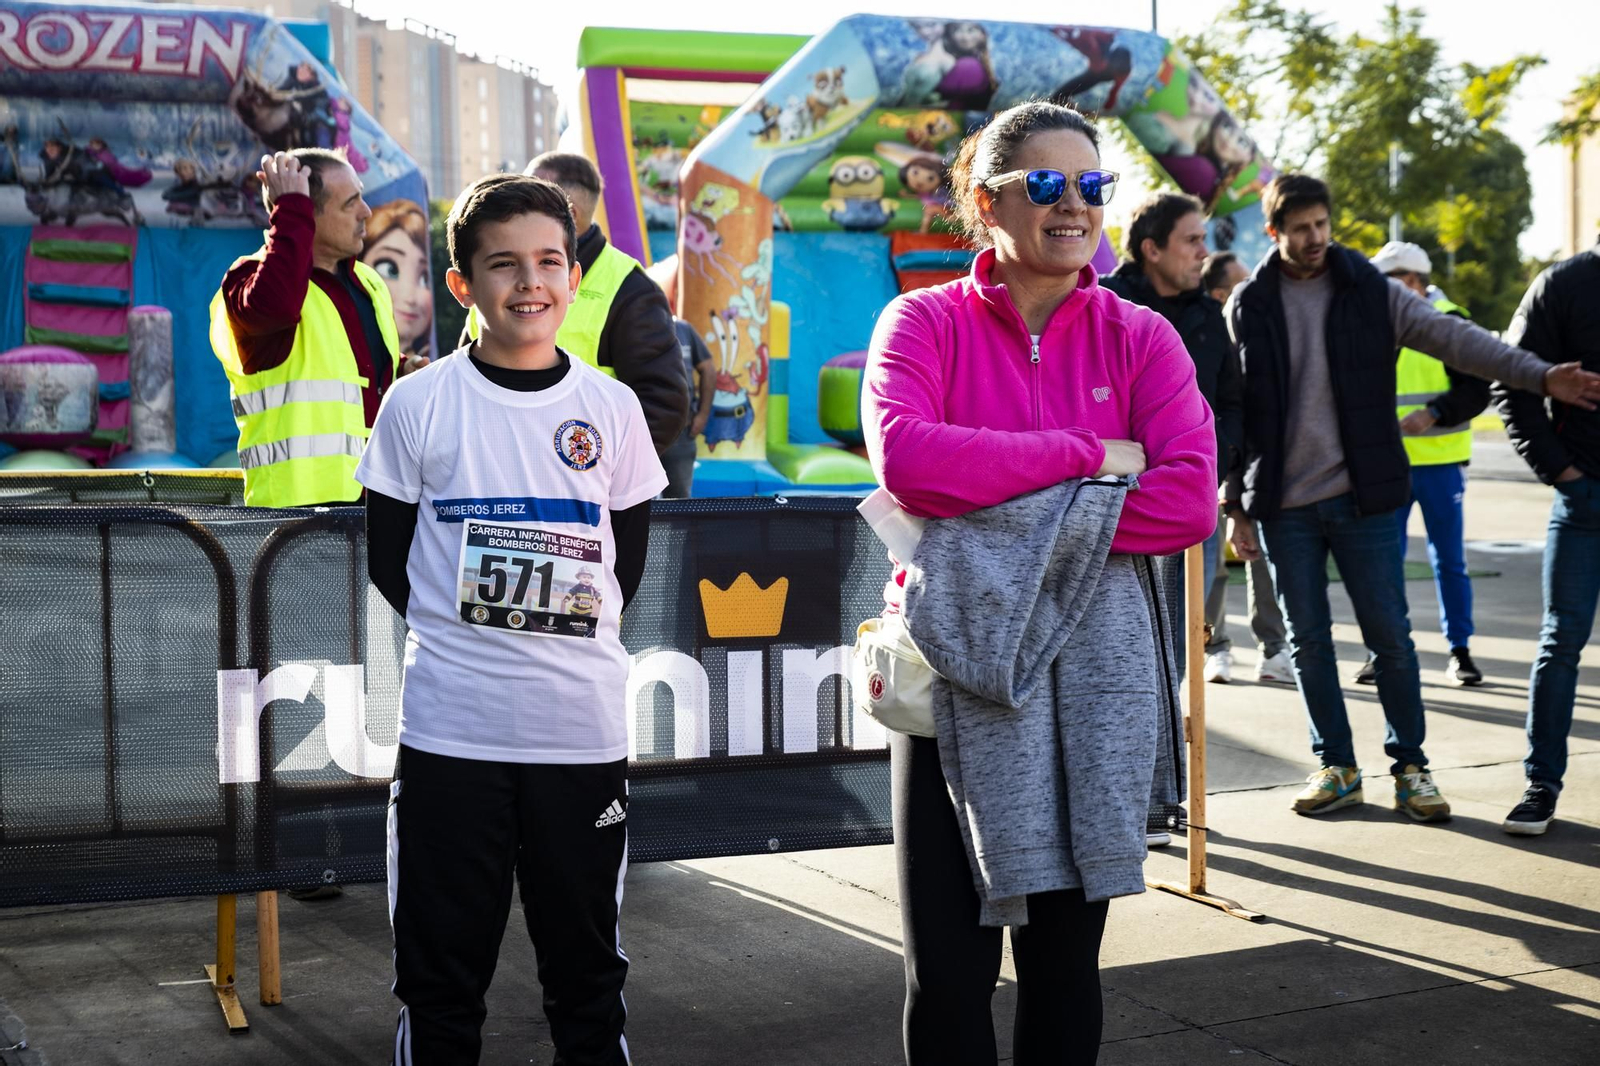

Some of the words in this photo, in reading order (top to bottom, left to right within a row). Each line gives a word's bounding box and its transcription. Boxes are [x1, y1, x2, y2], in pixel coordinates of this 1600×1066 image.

[1092, 386, 1111, 403] UP
[492, 504, 526, 514] JEREZ
[470, 525, 516, 538] CARRERA
[518, 530, 558, 544] INFANTIL
[560, 537, 600, 552] BENÉFICA
[488, 538, 546, 552] BOMBEROS
[548, 545, 560, 554] DE
[560, 547, 583, 559] JEREZ
[477, 554, 554, 608] 571
[595, 811, 626, 828] adidas
